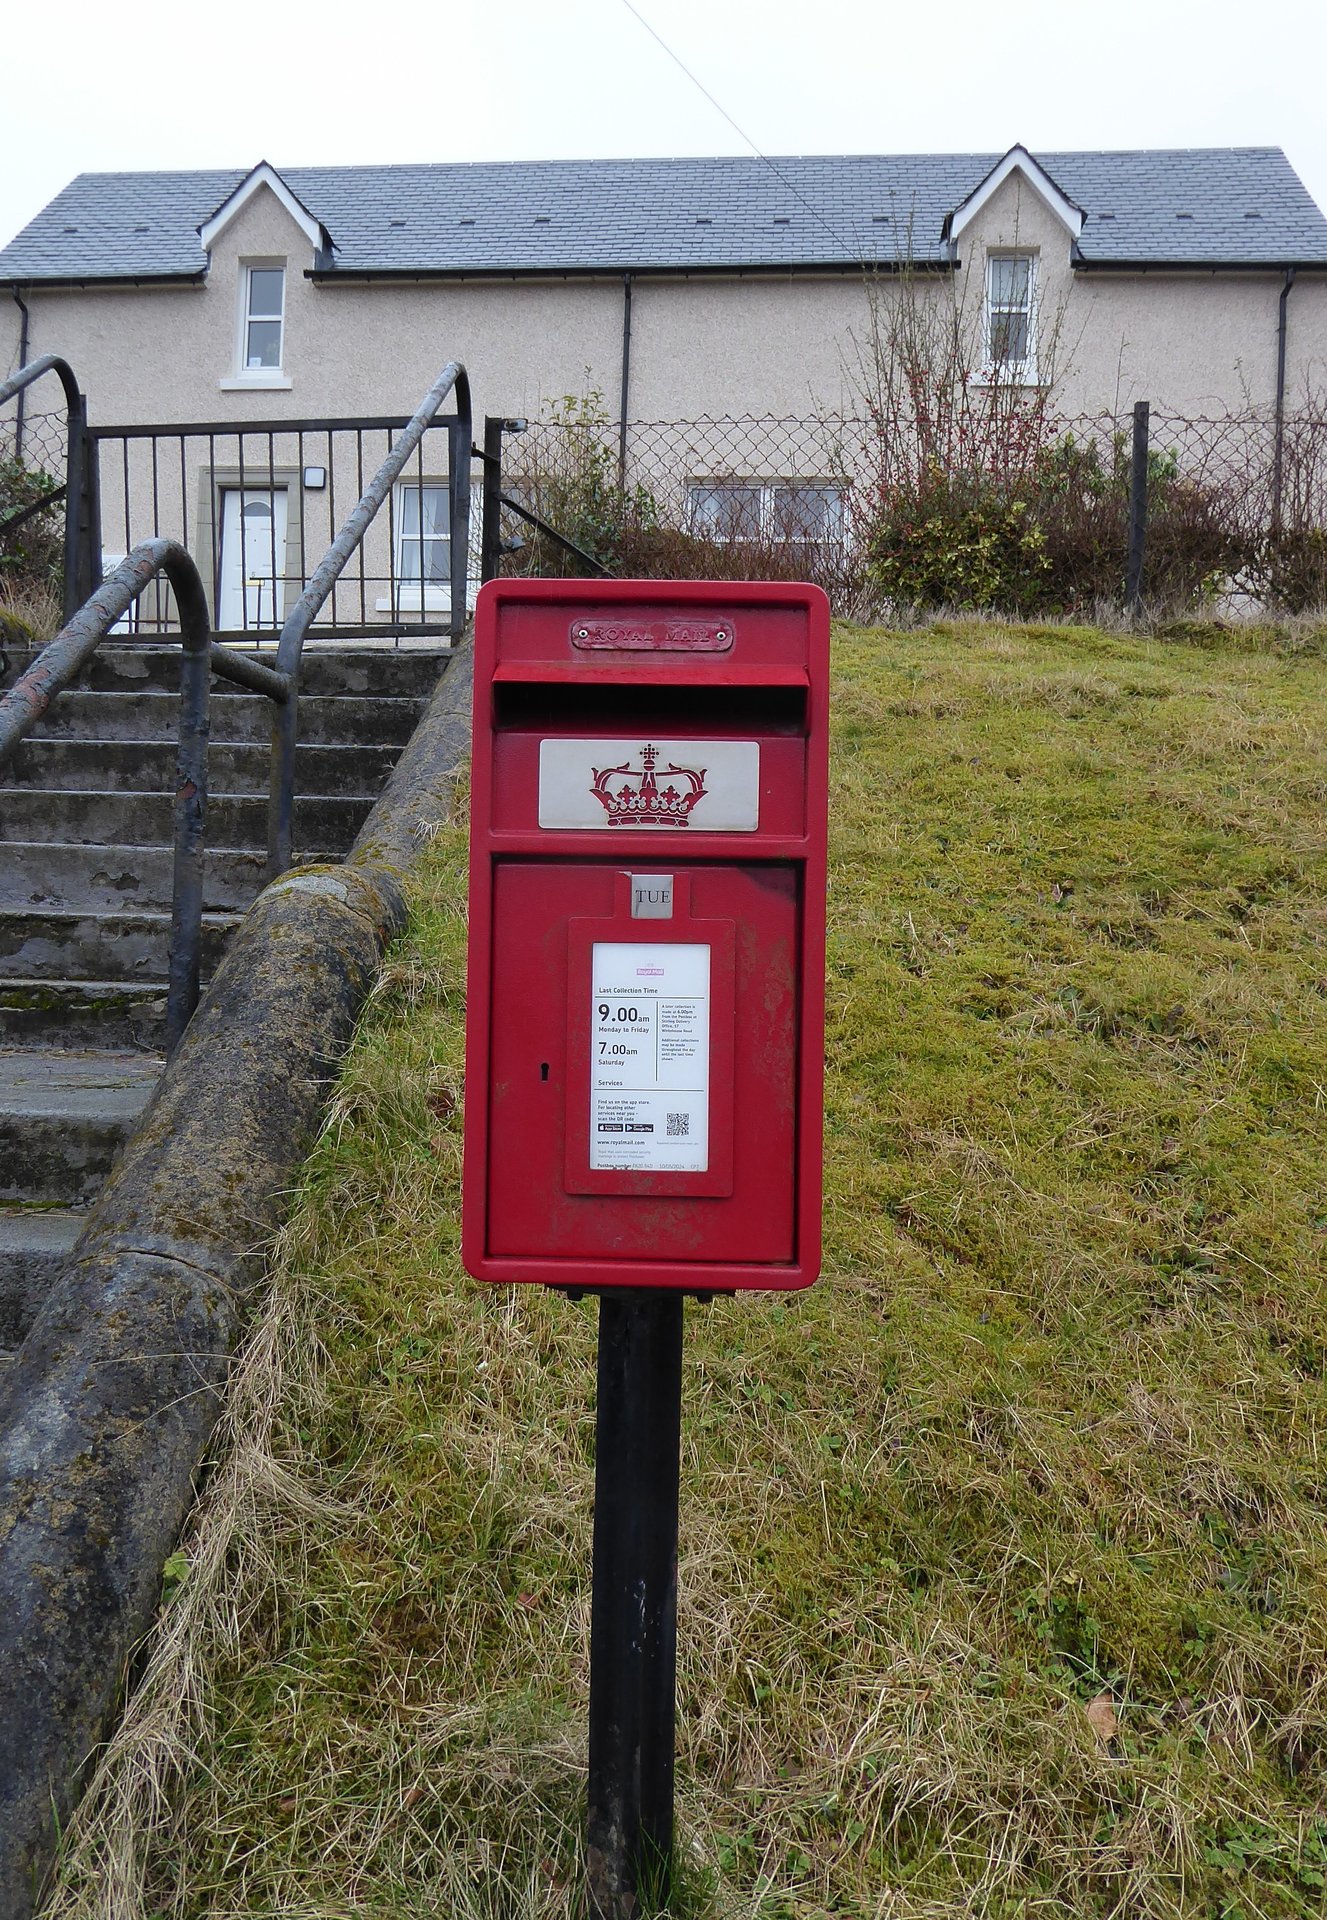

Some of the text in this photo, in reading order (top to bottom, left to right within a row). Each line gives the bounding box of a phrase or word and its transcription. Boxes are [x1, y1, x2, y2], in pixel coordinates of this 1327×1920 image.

[595, 628, 710, 642] ROYAL MAIL
[636, 890, 670, 903] TUE
[598, 1004, 650, 1022] 9.00am
[598, 1042, 638, 1055] 7.00am
